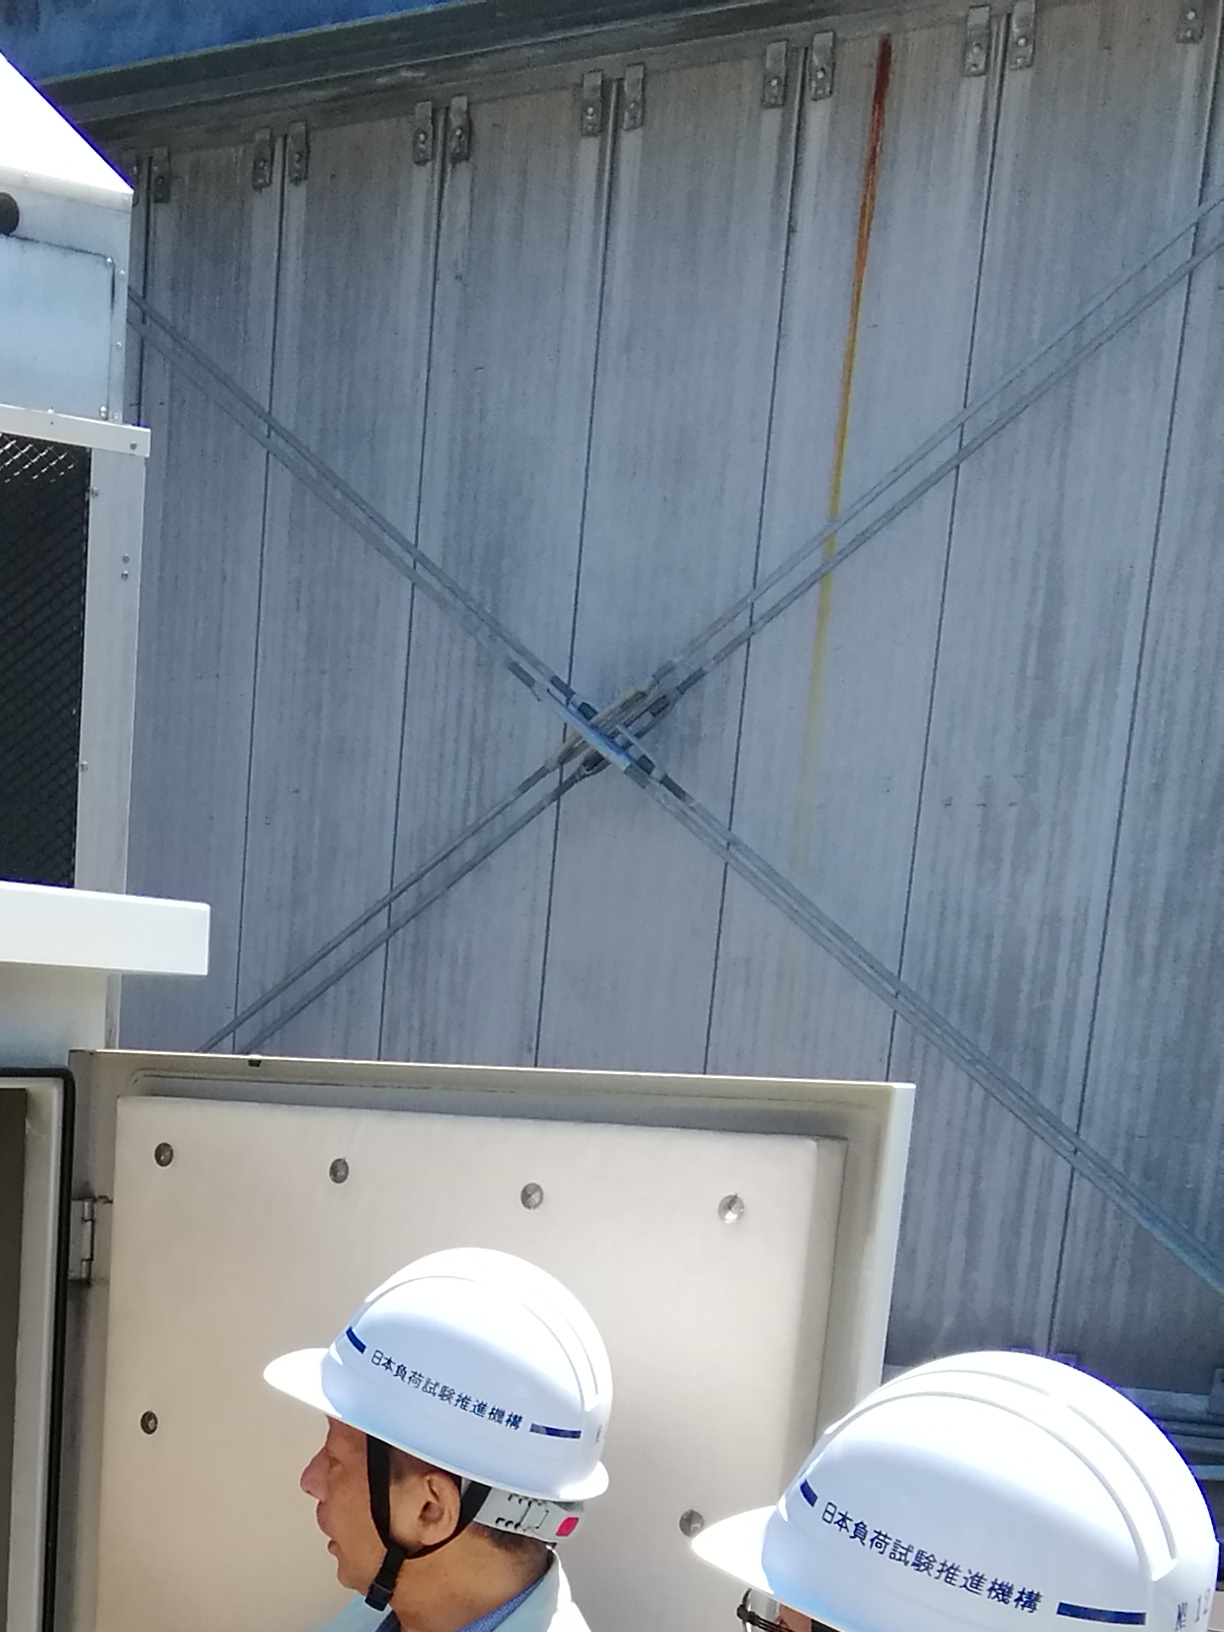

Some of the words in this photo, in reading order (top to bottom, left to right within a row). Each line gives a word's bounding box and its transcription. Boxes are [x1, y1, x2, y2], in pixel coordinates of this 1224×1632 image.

[371, 1350, 523, 1430] 日本負荷試験推進機構
[822, 1502, 1043, 1614] 日本負荷試験推進機構
